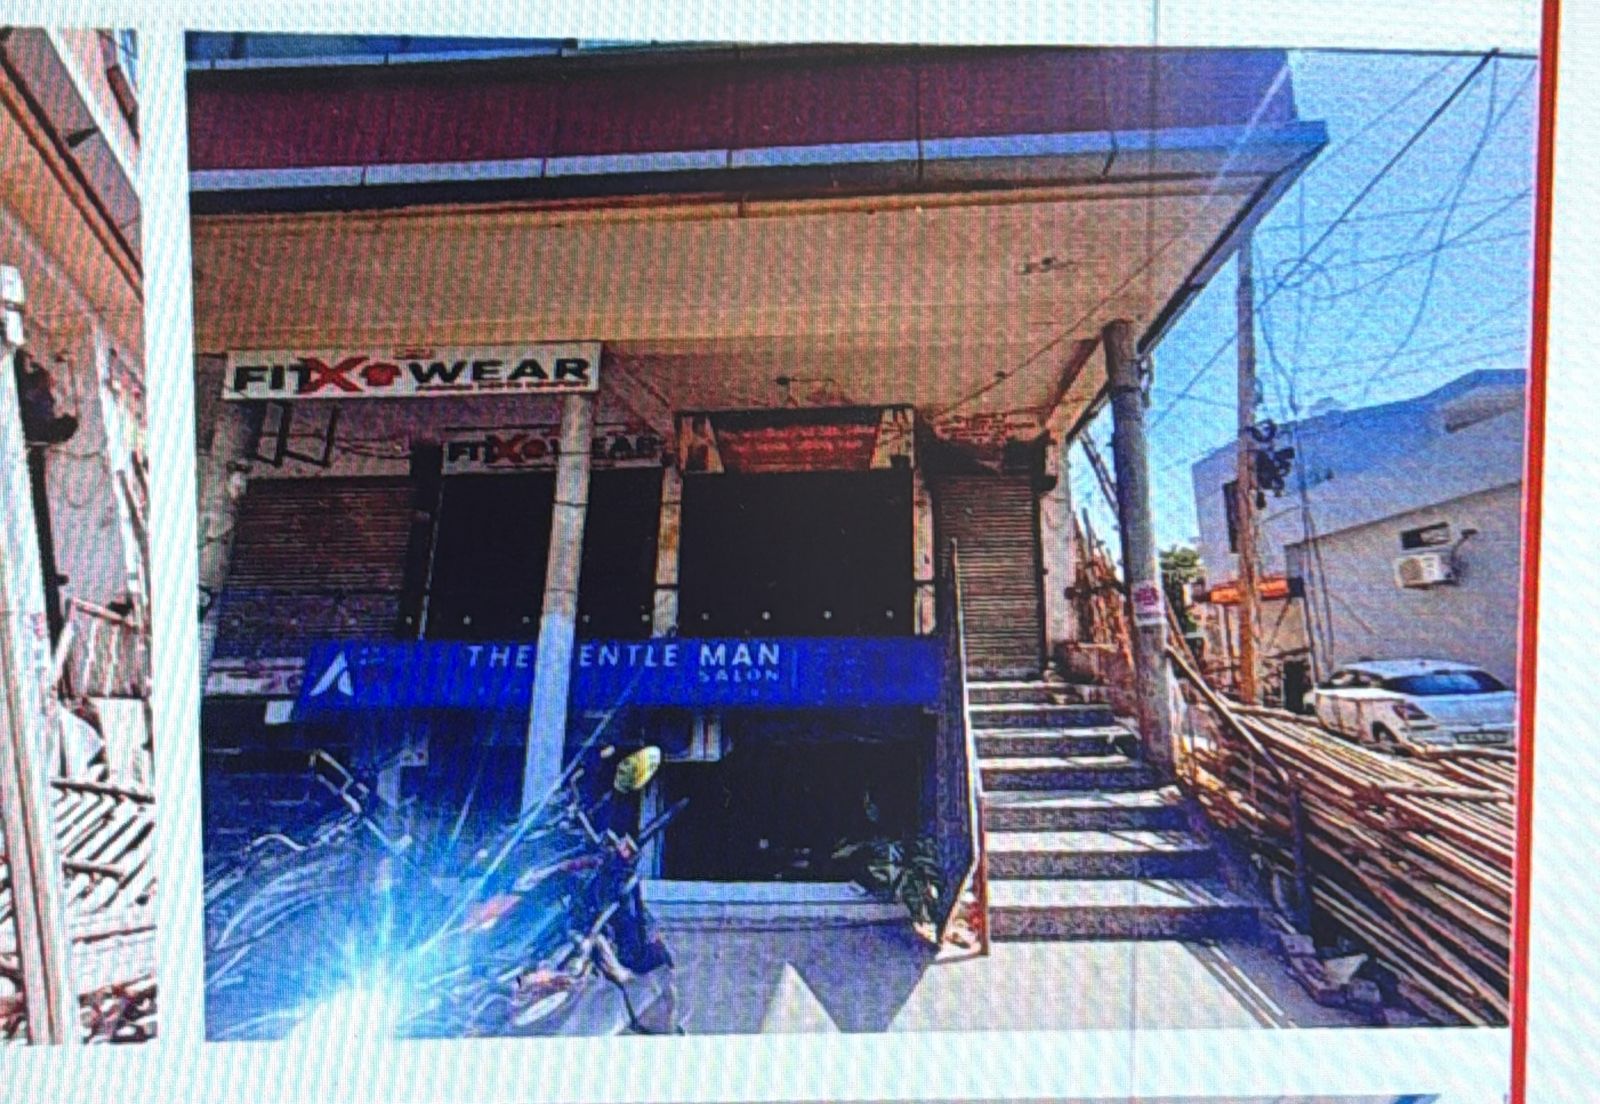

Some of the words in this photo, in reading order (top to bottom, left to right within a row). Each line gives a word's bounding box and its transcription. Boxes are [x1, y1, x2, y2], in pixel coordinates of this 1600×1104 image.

[408, 358, 590, 383] WEAR
[467, 645, 532, 668] THE
[579, 643, 679, 669] ENTLE
[699, 643, 781, 668] MAN
[698, 669, 780, 683] SALON
